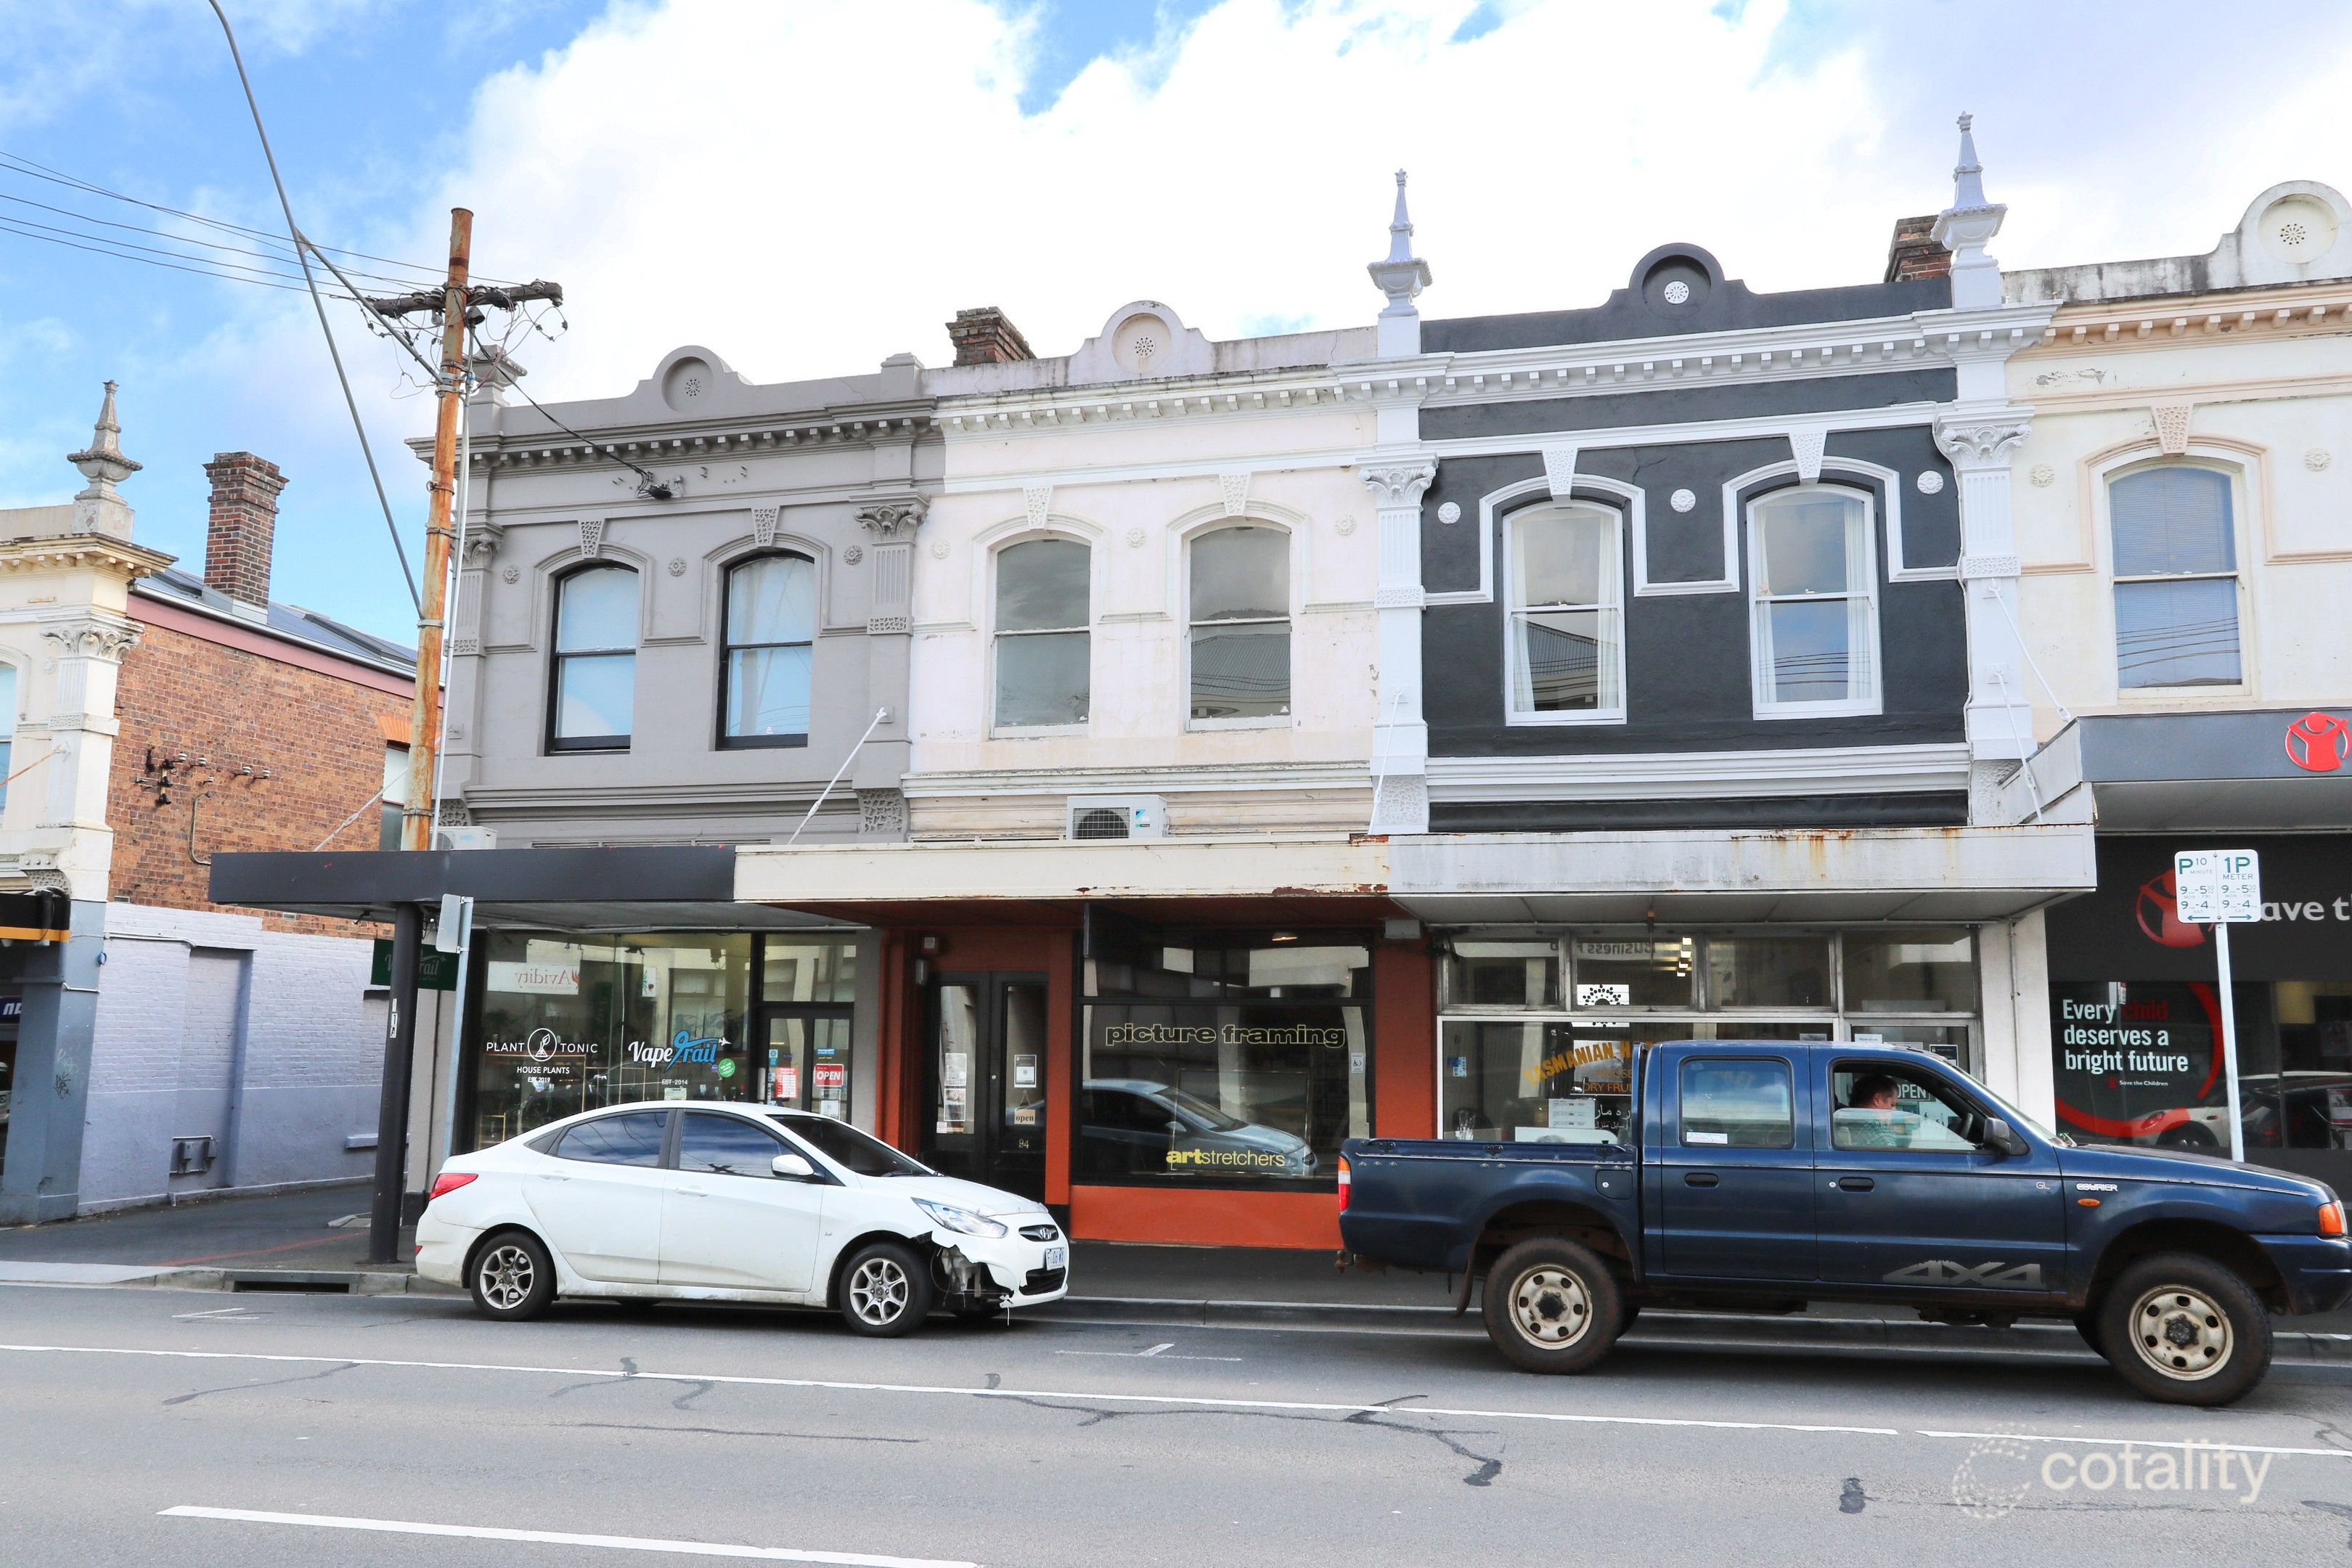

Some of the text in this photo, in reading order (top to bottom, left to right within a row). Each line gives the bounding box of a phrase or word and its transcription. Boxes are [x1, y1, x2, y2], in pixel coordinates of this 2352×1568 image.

[2224, 857, 2250, 873] 1P
[2261, 902, 2324, 921] ave
[2062, 999, 2168, 1024] Every child
[1106, 1024, 1345, 1048] picture framing
[2064, 1024, 2169, 1045] deserves a
[486, 1042, 598, 1053] PLANT TONIC
[627, 1041, 673, 1069] Vape
[2065, 1050, 2189, 1074] bright future
[816, 1071, 841, 1080] OPEN
[1583, 1082, 1607, 1093] DRY
[1016, 1114, 1034, 1122] open
[1018, 1138, 1029, 1148] 94
[1165, 1148, 1286, 1167] artstretchers
[2076, 1183, 2118, 1192] COURIER
